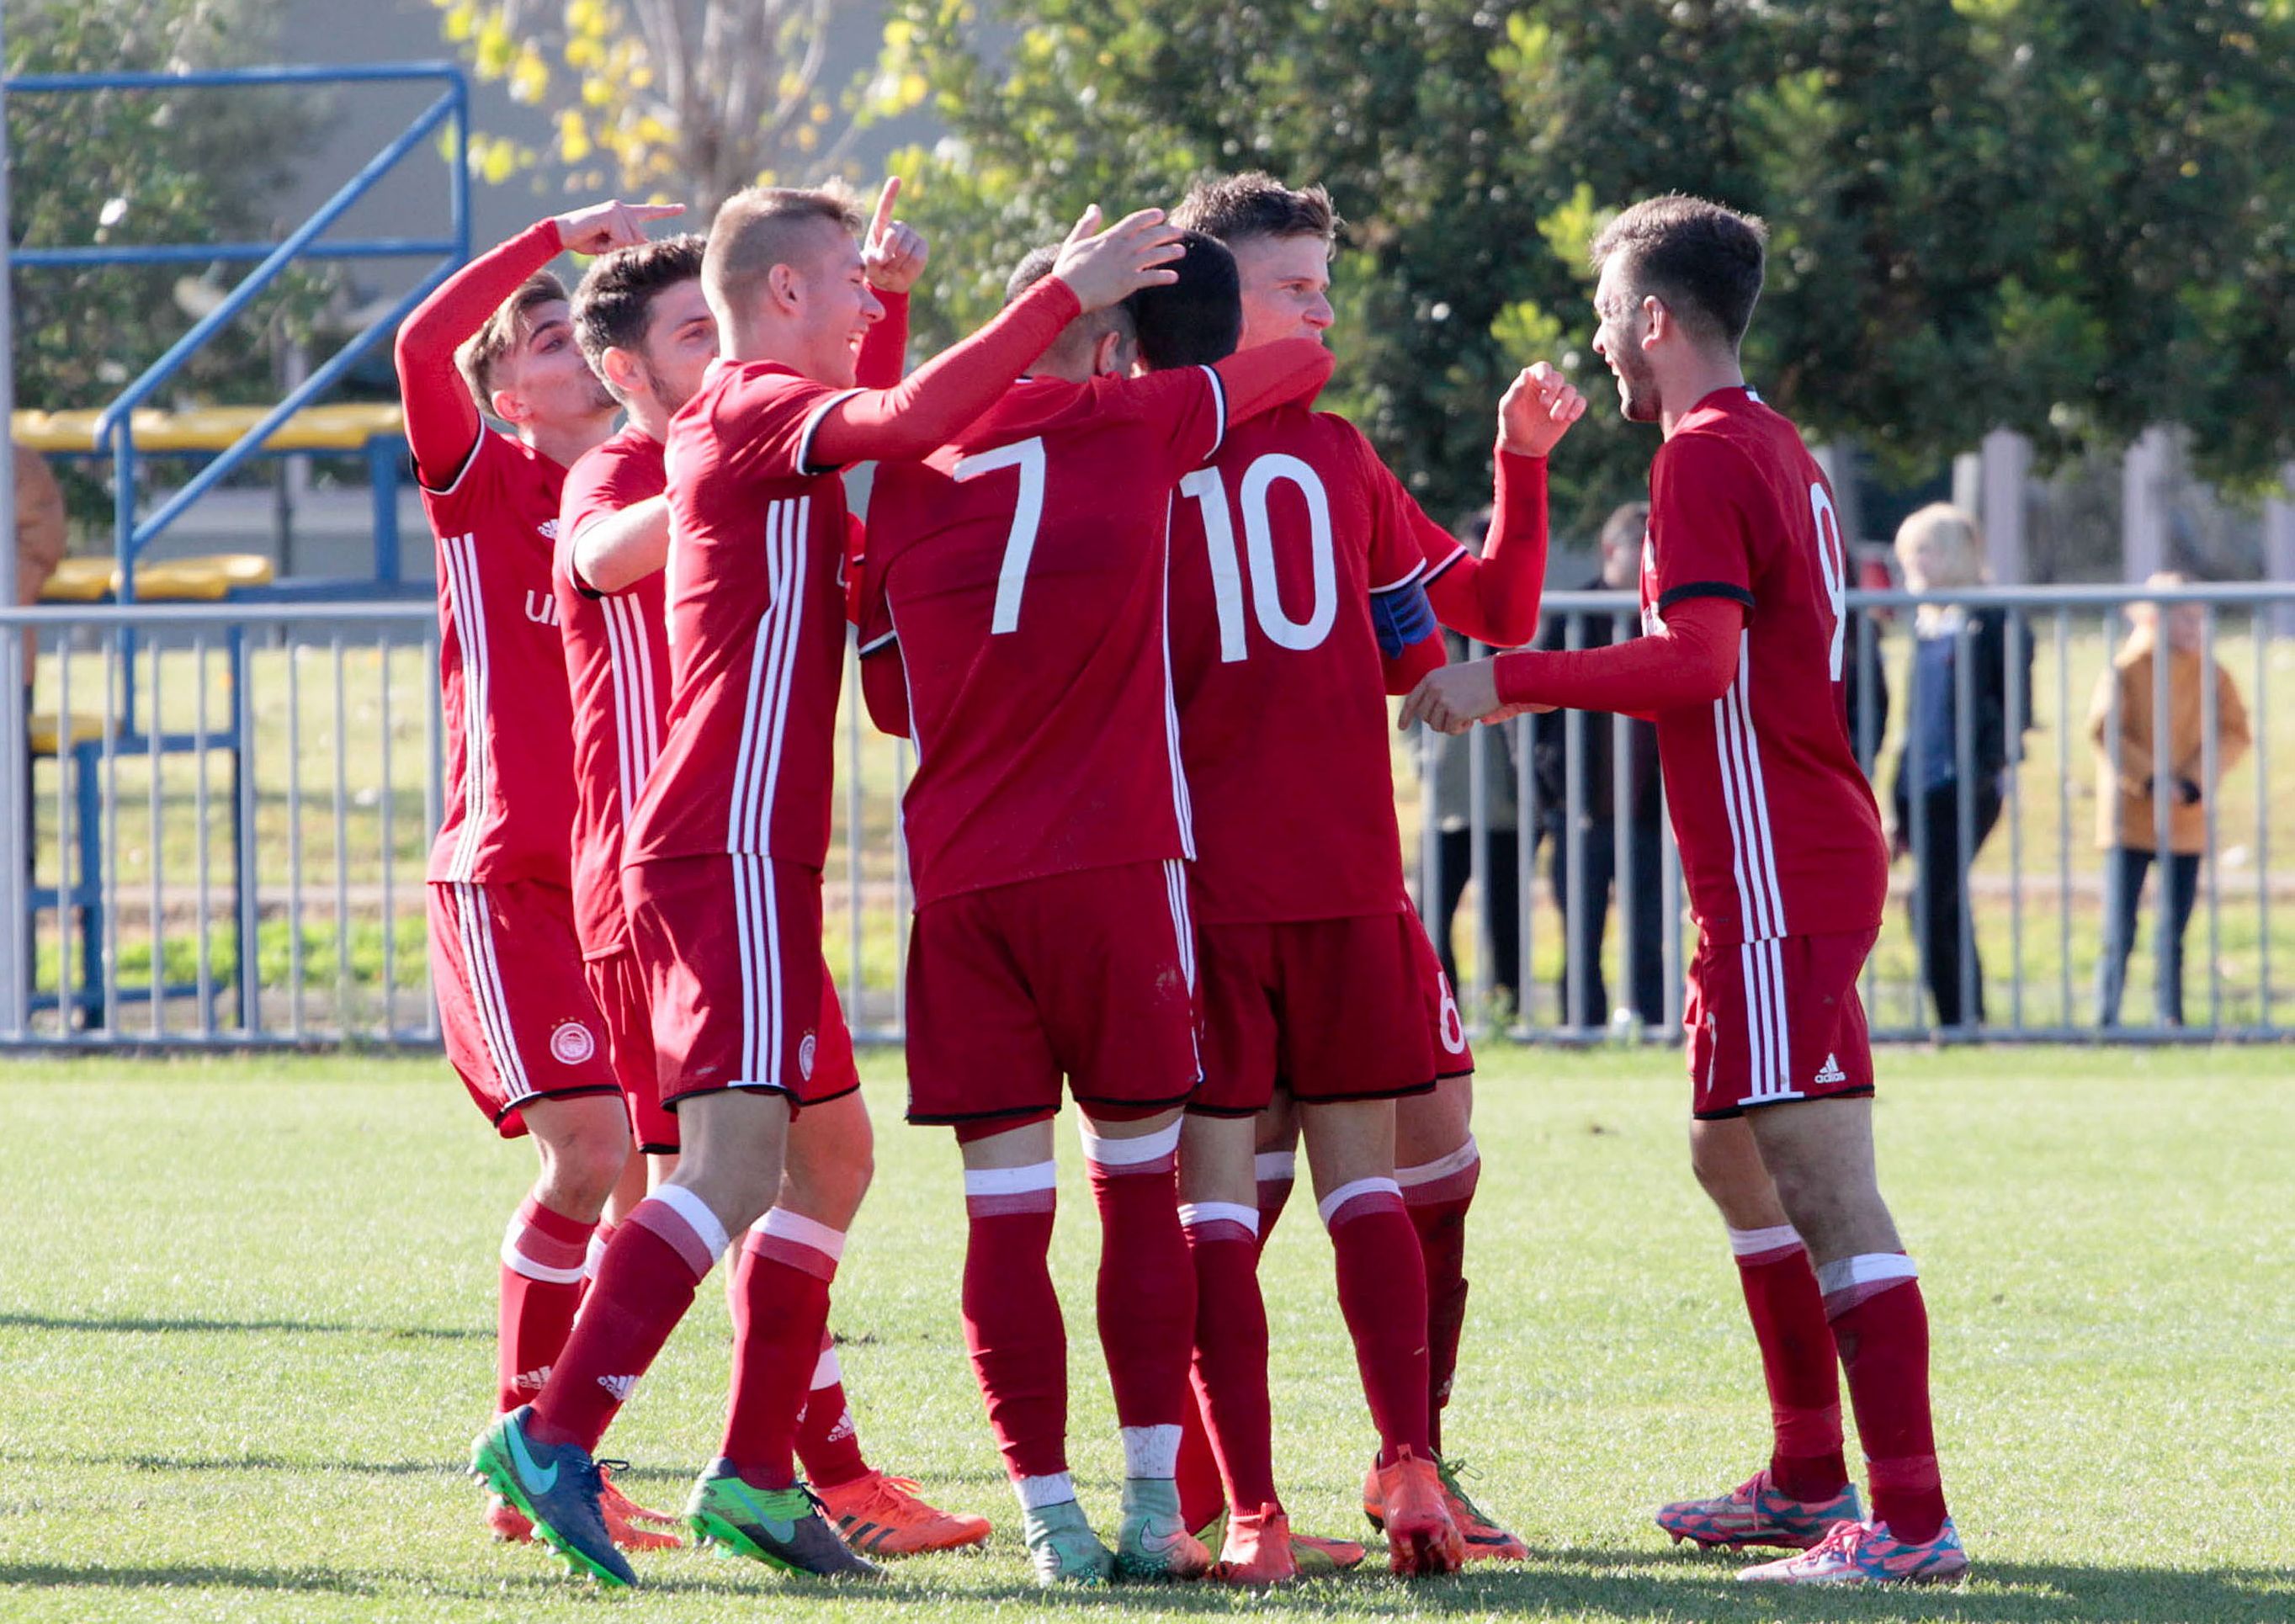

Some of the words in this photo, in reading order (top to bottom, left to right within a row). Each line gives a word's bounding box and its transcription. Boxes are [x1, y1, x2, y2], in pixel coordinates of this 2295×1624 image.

[953, 436, 1046, 634] 7
[1179, 453, 1337, 663] 10
[1810, 482, 1846, 682] 9
[1437, 971, 1465, 1054] 6
[1814, 1071, 1846, 1084] adidas
